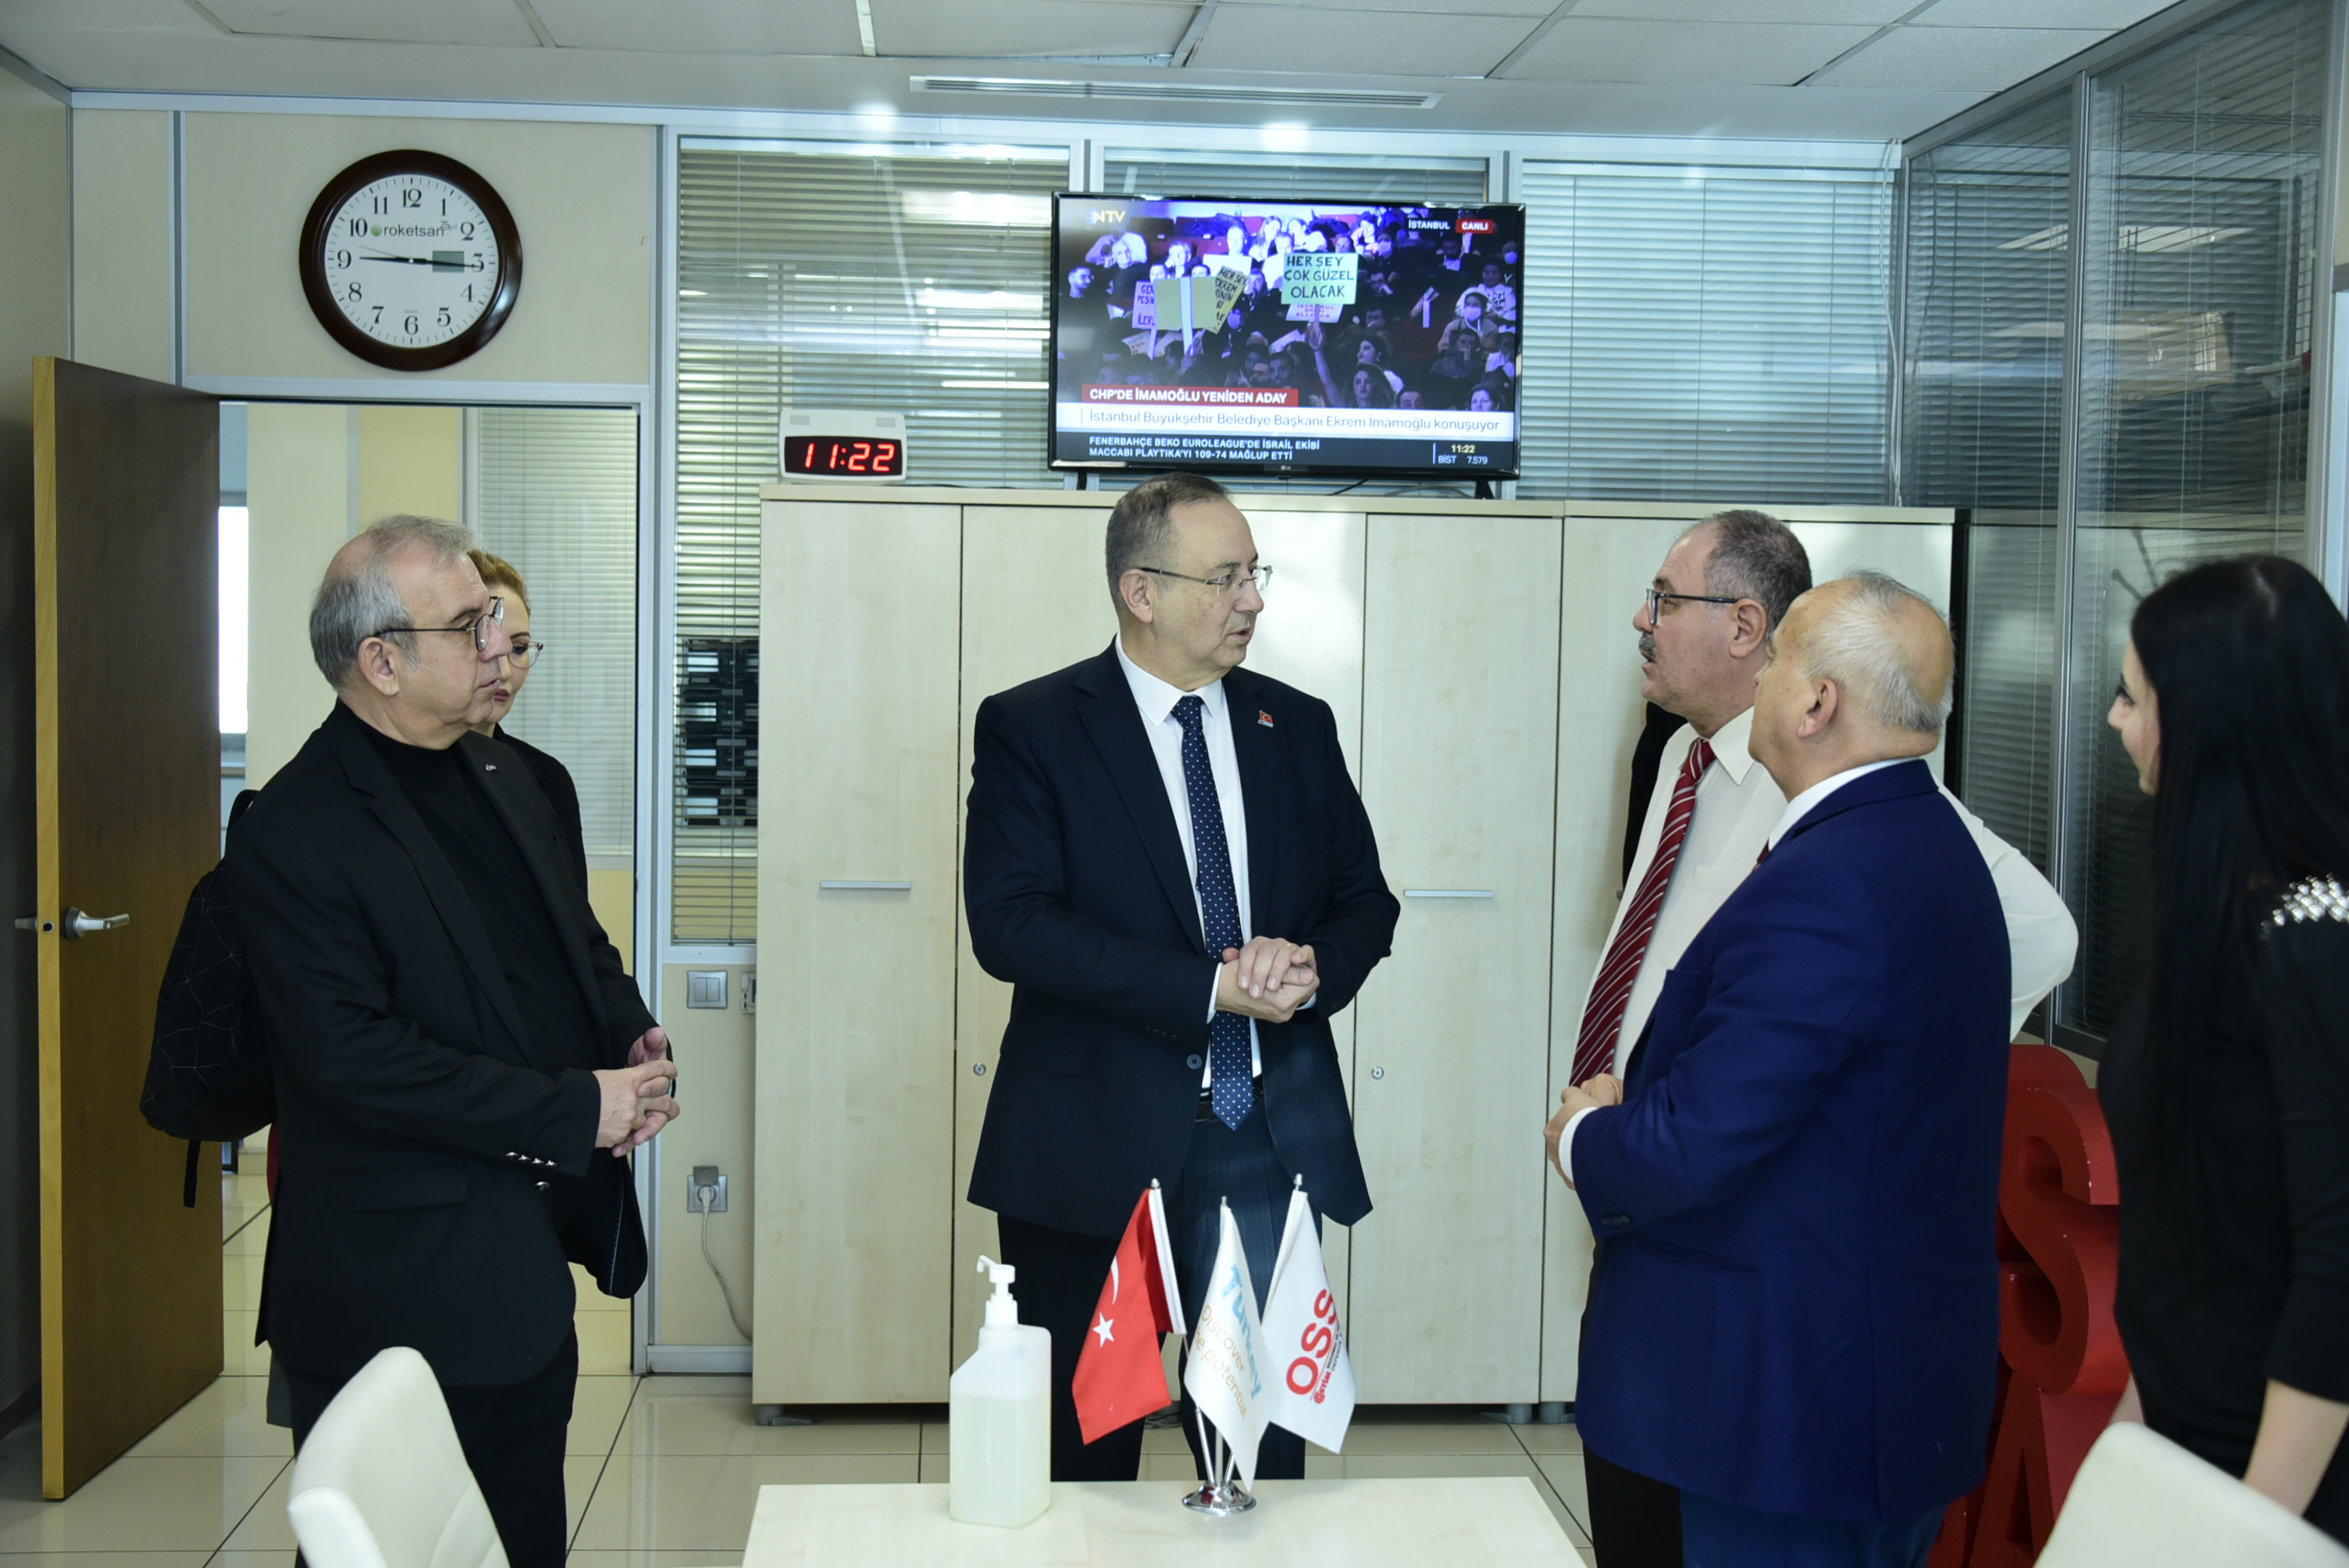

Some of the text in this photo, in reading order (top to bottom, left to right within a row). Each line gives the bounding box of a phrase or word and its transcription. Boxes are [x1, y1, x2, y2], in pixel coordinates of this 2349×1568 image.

[372, 196, 389, 216] 11
[401, 188, 422, 208] 12
[440, 197, 447, 216] 1
[1094, 209, 1126, 223] NTV
[1408, 219, 1451, 230] İSTANBUL
[349, 218, 368, 237] 10
[384, 224, 444, 237] roketsan
[460, 222, 475, 241] 2
[1461, 221, 1489, 231] CANLI
[337, 250, 351, 269] 9
[471, 253, 485, 273] 3
[1287, 255, 1313, 267] HER
[1218, 267, 1235, 281] HER
[1284, 269, 1355, 283] ÇOK GÜZEL
[348, 282, 362, 302] 8
[459, 283, 476, 303] 4
[1290, 285, 1345, 299] OLACAK
[371, 305, 385, 325] 7
[437, 307, 451, 328] 5
[405, 315, 419, 336] 6
[1089, 387, 1288, 404] CHP'DE İMAMOĞLU YENİDEN ADAY
[1090, 408, 1500, 432] İstanbul Büyükşehir Belediye Başkanı Ekrem İmamoğlu konuşuyor
[1089, 436, 1321, 451] FENERBAHÇE BEKO EUROLEAGUE'DE İSRAİL EKİBİ
[1451, 444, 1476, 454] 11:22
[805, 443, 895, 472] 11:22
[1089, 447, 1293, 461] MACCABI PLAYTIKA'YI 109-74 MAĞLUP ETTİ
[1466, 455, 1488, 465] 7.579
[1200, 1304, 1245, 1372] Discover
[1200, 1349, 1248, 1420] potential
